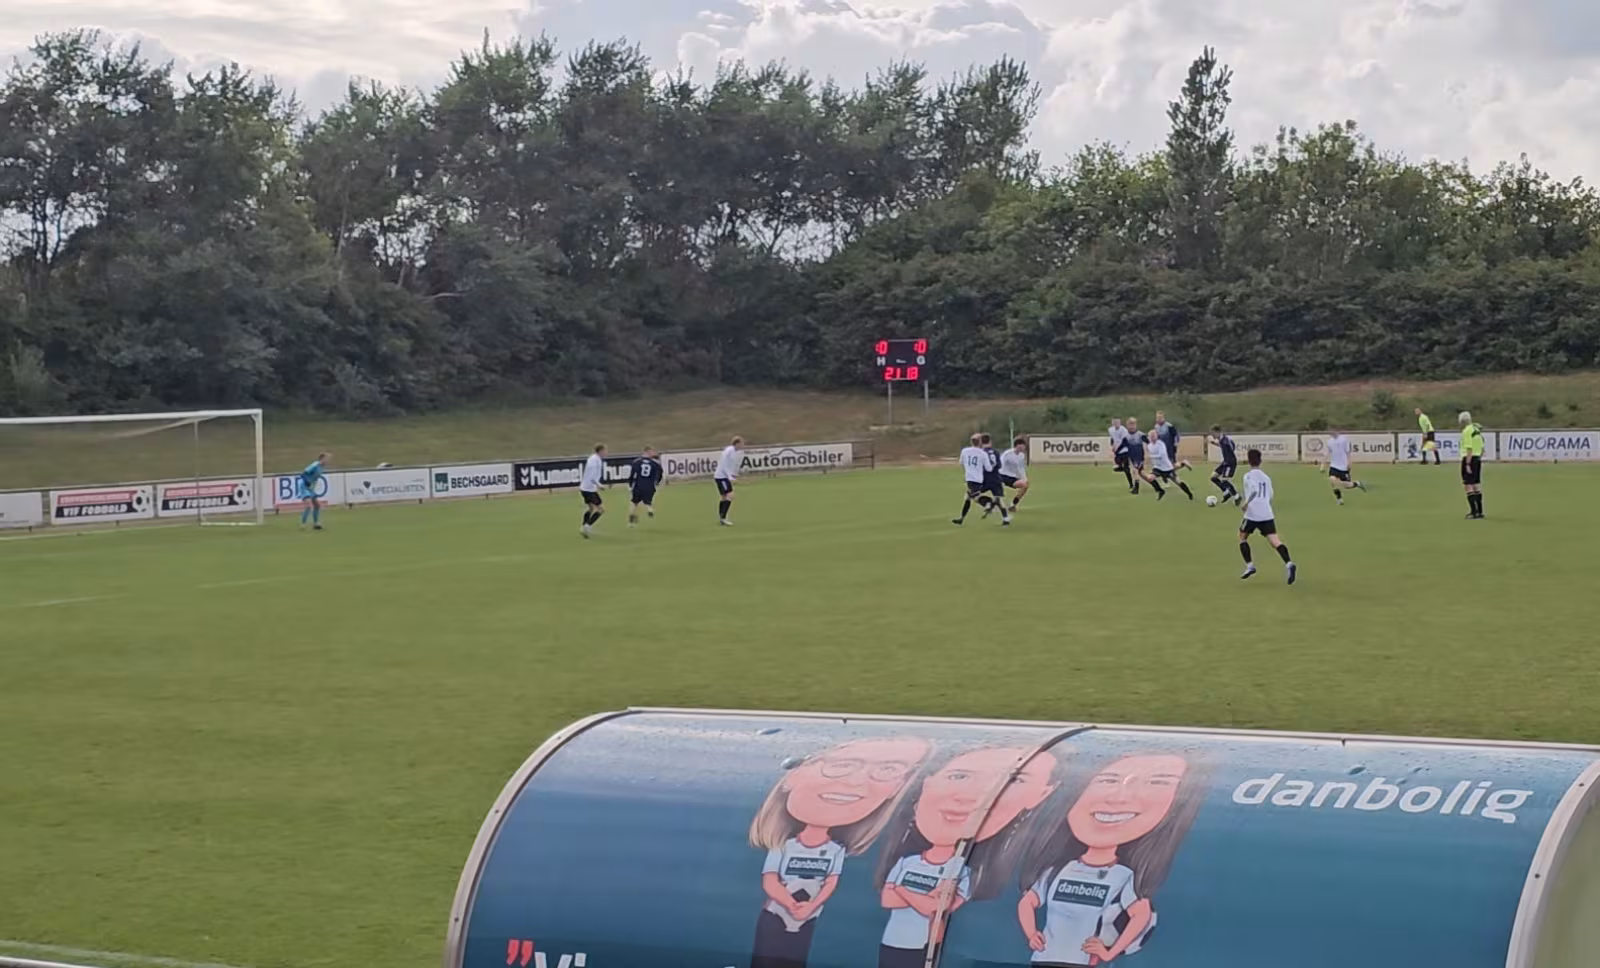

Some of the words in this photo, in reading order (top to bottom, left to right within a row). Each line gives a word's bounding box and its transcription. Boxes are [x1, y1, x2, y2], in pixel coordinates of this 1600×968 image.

[1043, 440, 1100, 453] ProVarde
[1362, 441, 1392, 453] Lund
[1508, 435, 1591, 450] INDORAMA
[668, 458, 718, 475] Deloitte
[740, 449, 844, 468] Automobiler
[967, 455, 978, 467] 14
[451, 474, 509, 489] BECHSGAARD
[530, 463, 583, 486] hummel
[1231, 773, 1534, 824] danbolig
[1058, 881, 1107, 900] danbolig
